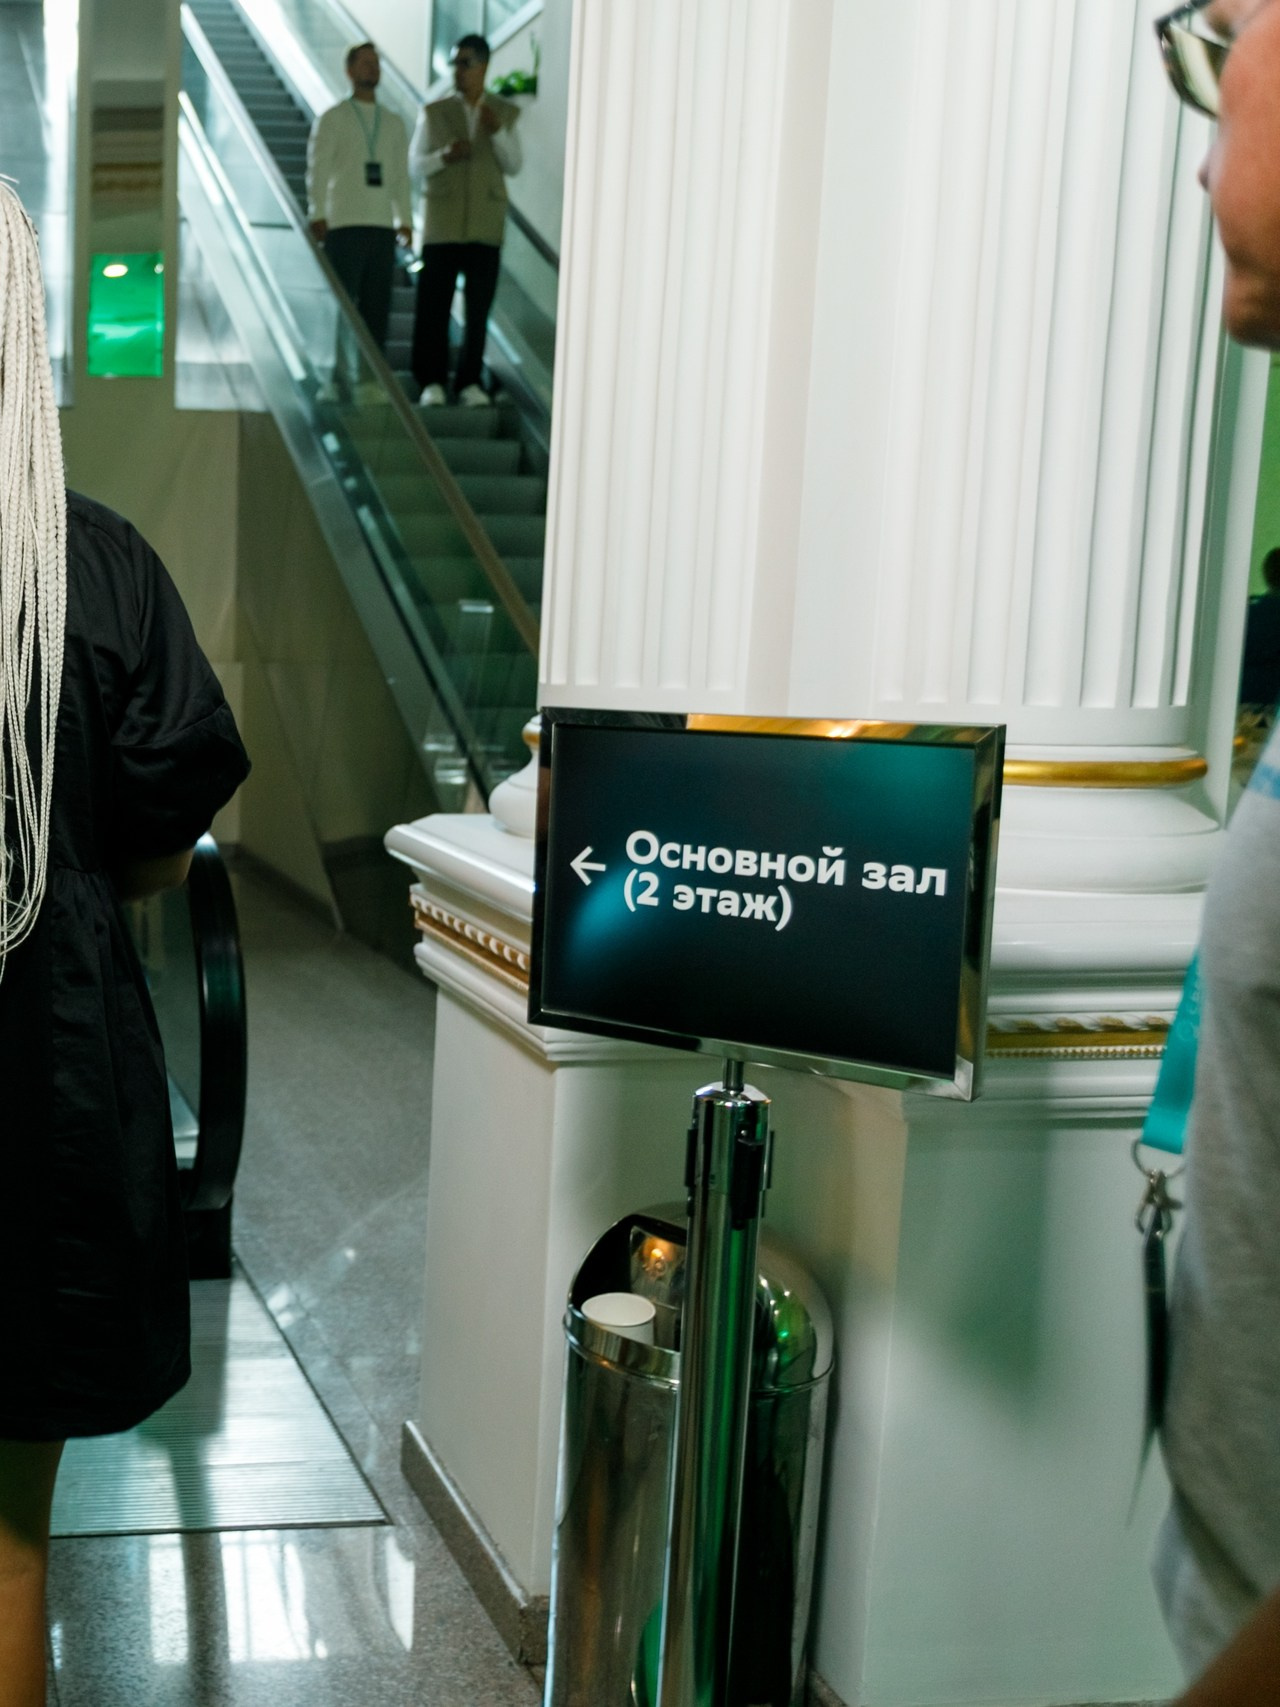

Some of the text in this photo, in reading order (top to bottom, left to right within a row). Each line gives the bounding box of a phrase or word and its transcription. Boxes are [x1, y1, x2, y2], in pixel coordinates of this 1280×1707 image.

[625, 830, 947, 897] Основной зал
[623, 868, 793, 932] (2 этаж)
